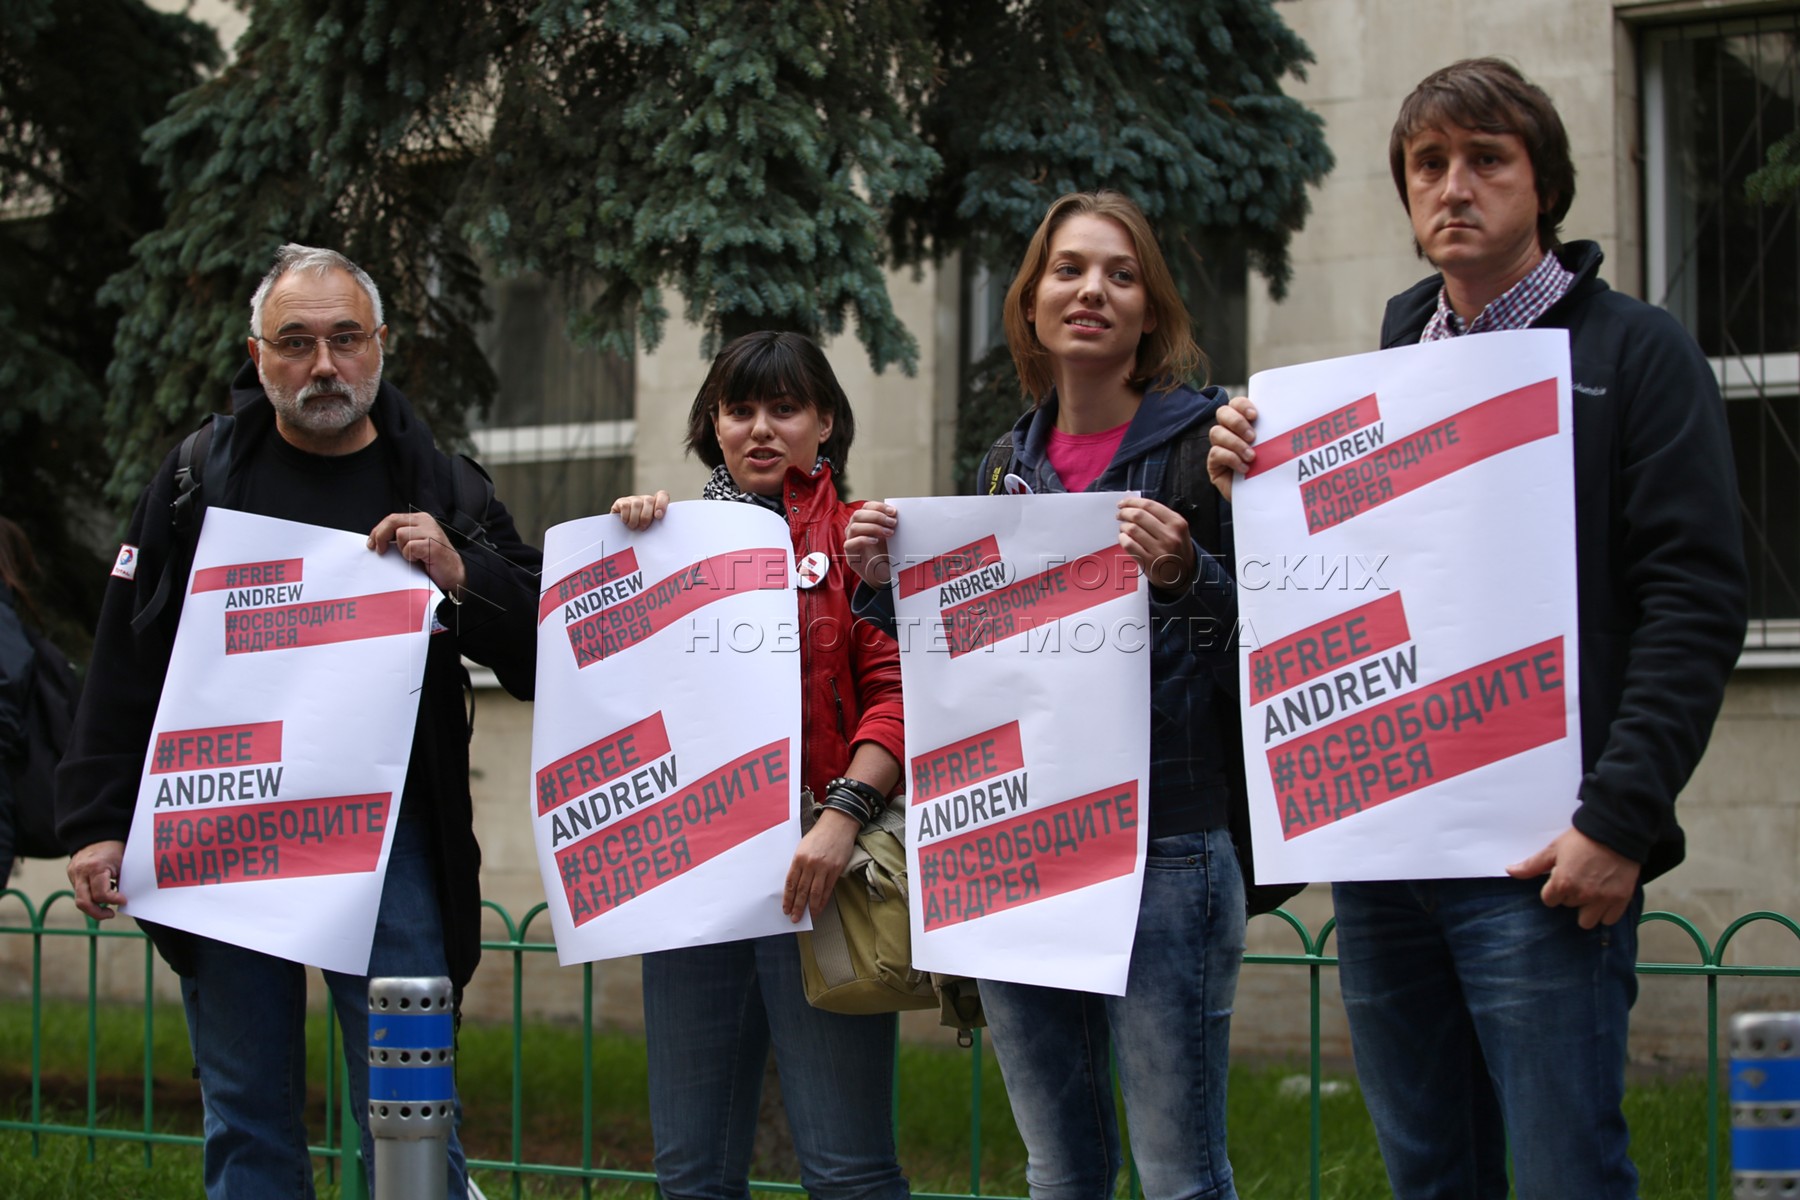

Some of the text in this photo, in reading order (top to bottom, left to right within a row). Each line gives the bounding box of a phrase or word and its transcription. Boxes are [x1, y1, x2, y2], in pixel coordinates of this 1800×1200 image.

[1291, 408, 1360, 455] #FREE
[1297, 423, 1385, 482] ANDREW
[1304, 422, 1460, 509] #ОСВОБОДИТЕ
[1308, 477, 1394, 532] АНДРЕЯ
[226, 564, 285, 587] #FREE
[558, 559, 619, 602] #FREE
[933, 546, 982, 581] #FREE
[939, 563, 1005, 607] ANDREW
[225, 584, 303, 609] ANDREW
[226, 602, 356, 632] #ОСВОБОДИТЕ
[564, 571, 644, 625] ANDREW
[571, 566, 705, 647] #ОСВОБОДИТЕ
[947, 571, 1068, 634] #ОСВОБОДИТЕ
[225, 628, 298, 652] АНДРЕЯ
[578, 619, 652, 667] АНДРЕЯ
[950, 614, 1015, 653] АНДРЕЯ
[1254, 616, 1372, 694] #FREE
[1265, 645, 1417, 743] ANDREW
[1274, 650, 1563, 793] #ОСВОБОДИТЕ
[157, 731, 253, 769] #FREE
[540, 734, 640, 808] #FREE
[916, 738, 997, 798] #FREE
[154, 767, 283, 808] ANDREW
[552, 754, 677, 848] ANDREW
[918, 772, 1028, 842] ANDREW
[1283, 748, 1434, 835] АНДРЕЯ
[156, 802, 383, 850] #ОСВОБОДИТЕ
[562, 748, 787, 887] #ОСВОБОДИТЕ
[923, 792, 1136, 888] #ОСВОБОДИТЕ
[157, 844, 279, 884] АНДРЕЯ
[572, 835, 691, 921] АНДРЕЯ
[925, 861, 1040, 926] АНДРЕЯ
